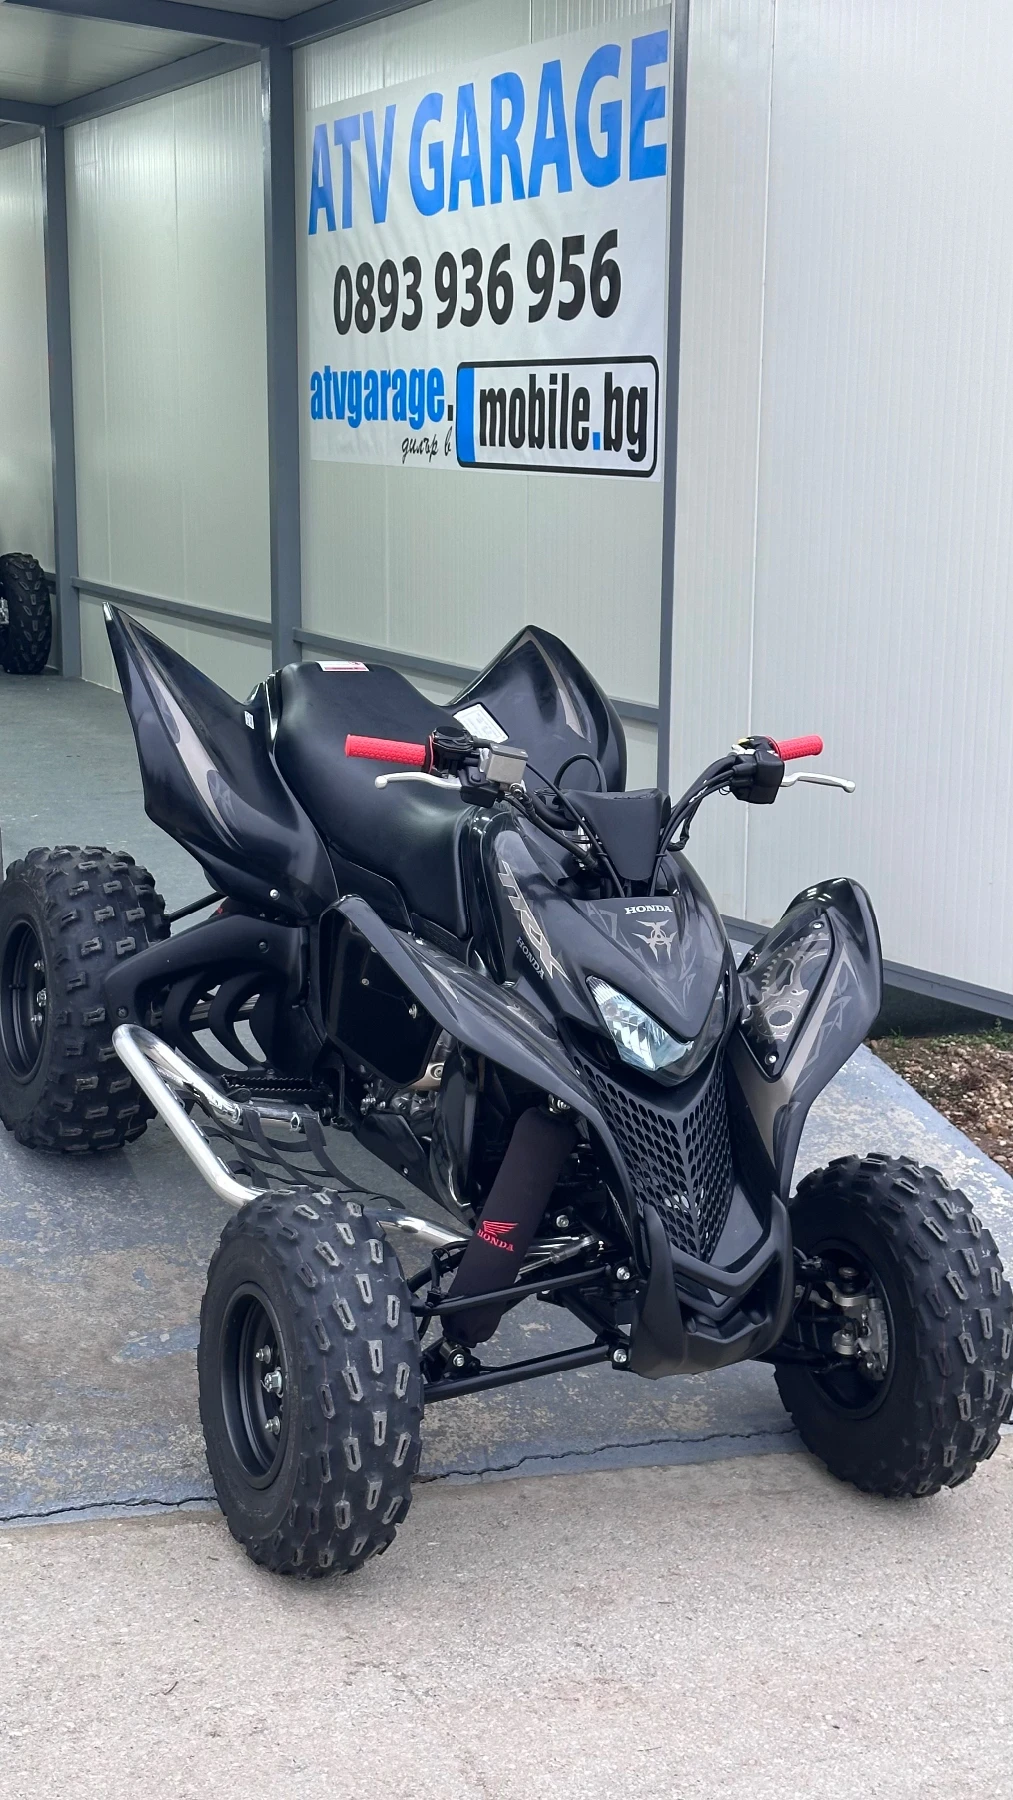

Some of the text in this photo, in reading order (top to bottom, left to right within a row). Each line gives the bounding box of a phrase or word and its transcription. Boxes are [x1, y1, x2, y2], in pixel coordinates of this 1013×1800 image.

[308, 30, 668, 235] ATV GARAGE
[333, 228, 622, 335] 0893 936 956
[479, 371, 648, 463] mobile.bg
[401, 433, 439, 464] дилър
[624, 904, 673, 915] HONDA
[516, 936, 545, 980] HONDA
[477, 1229, 514, 1252] HONDA
